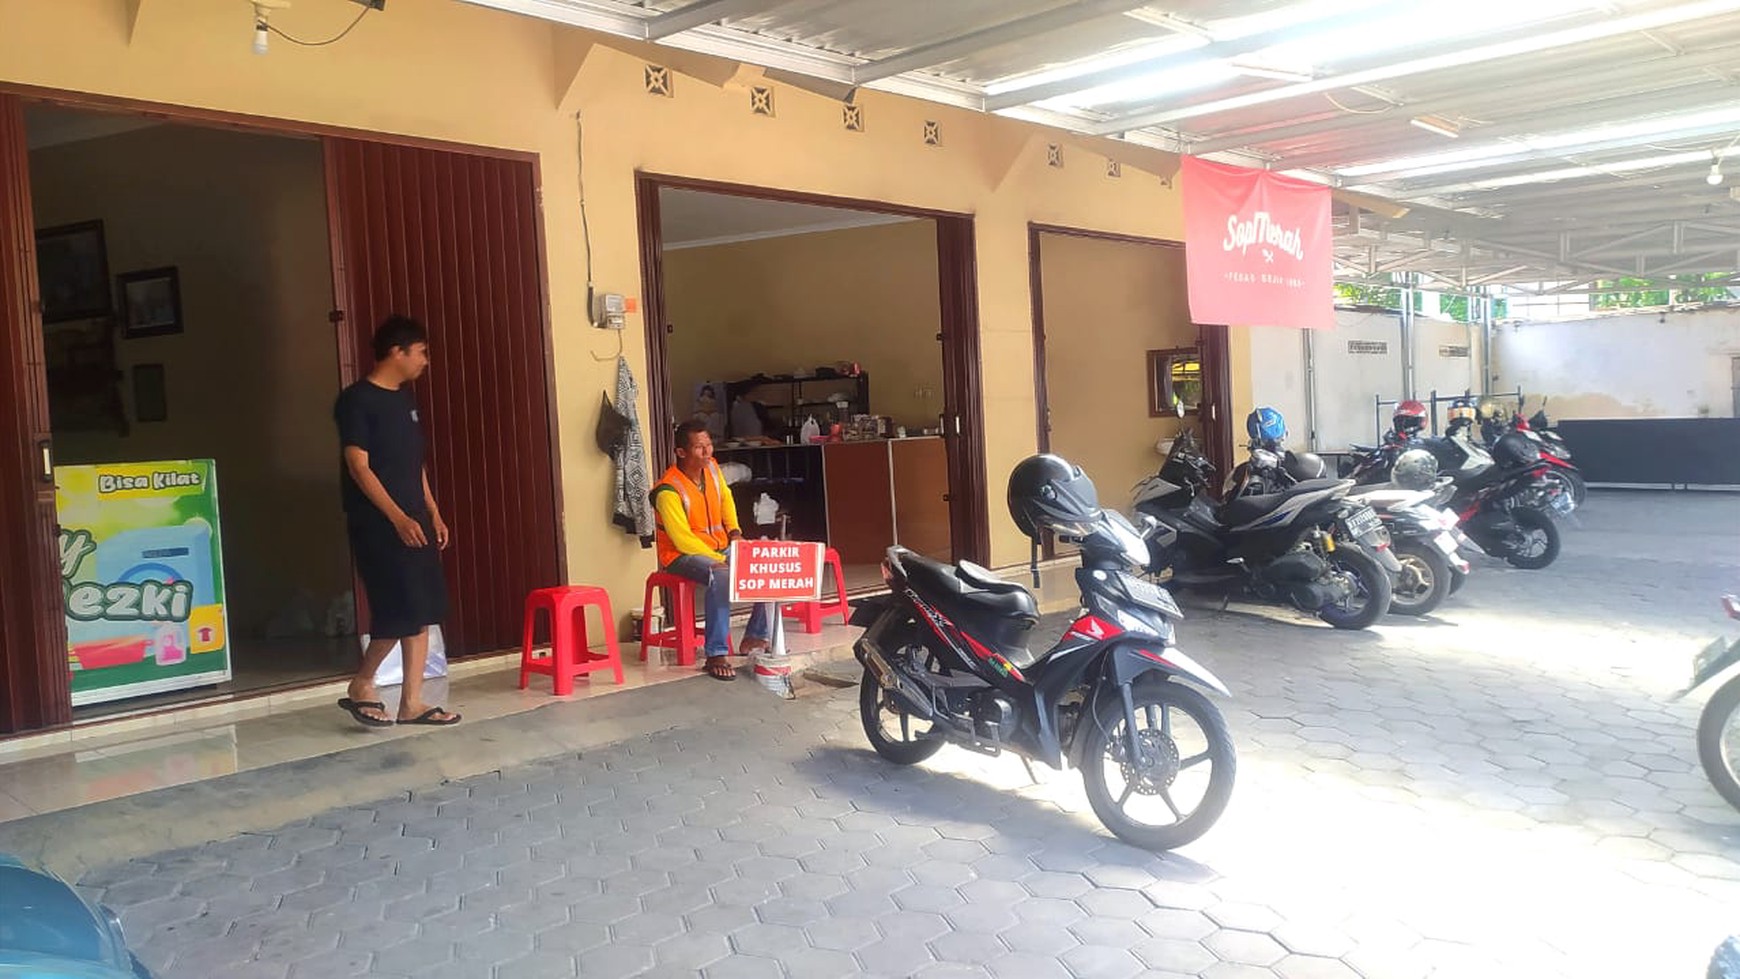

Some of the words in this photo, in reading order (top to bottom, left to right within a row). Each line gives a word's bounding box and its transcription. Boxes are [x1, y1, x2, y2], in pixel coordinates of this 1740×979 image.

[99, 474, 149, 493] Bisa
[152, 471, 200, 490] Kilat
[752, 547, 800, 558] PARKIR
[749, 562, 802, 574] KHUSUS
[739, 579, 765, 590] SOP
[769, 577, 814, 589] MERAH
